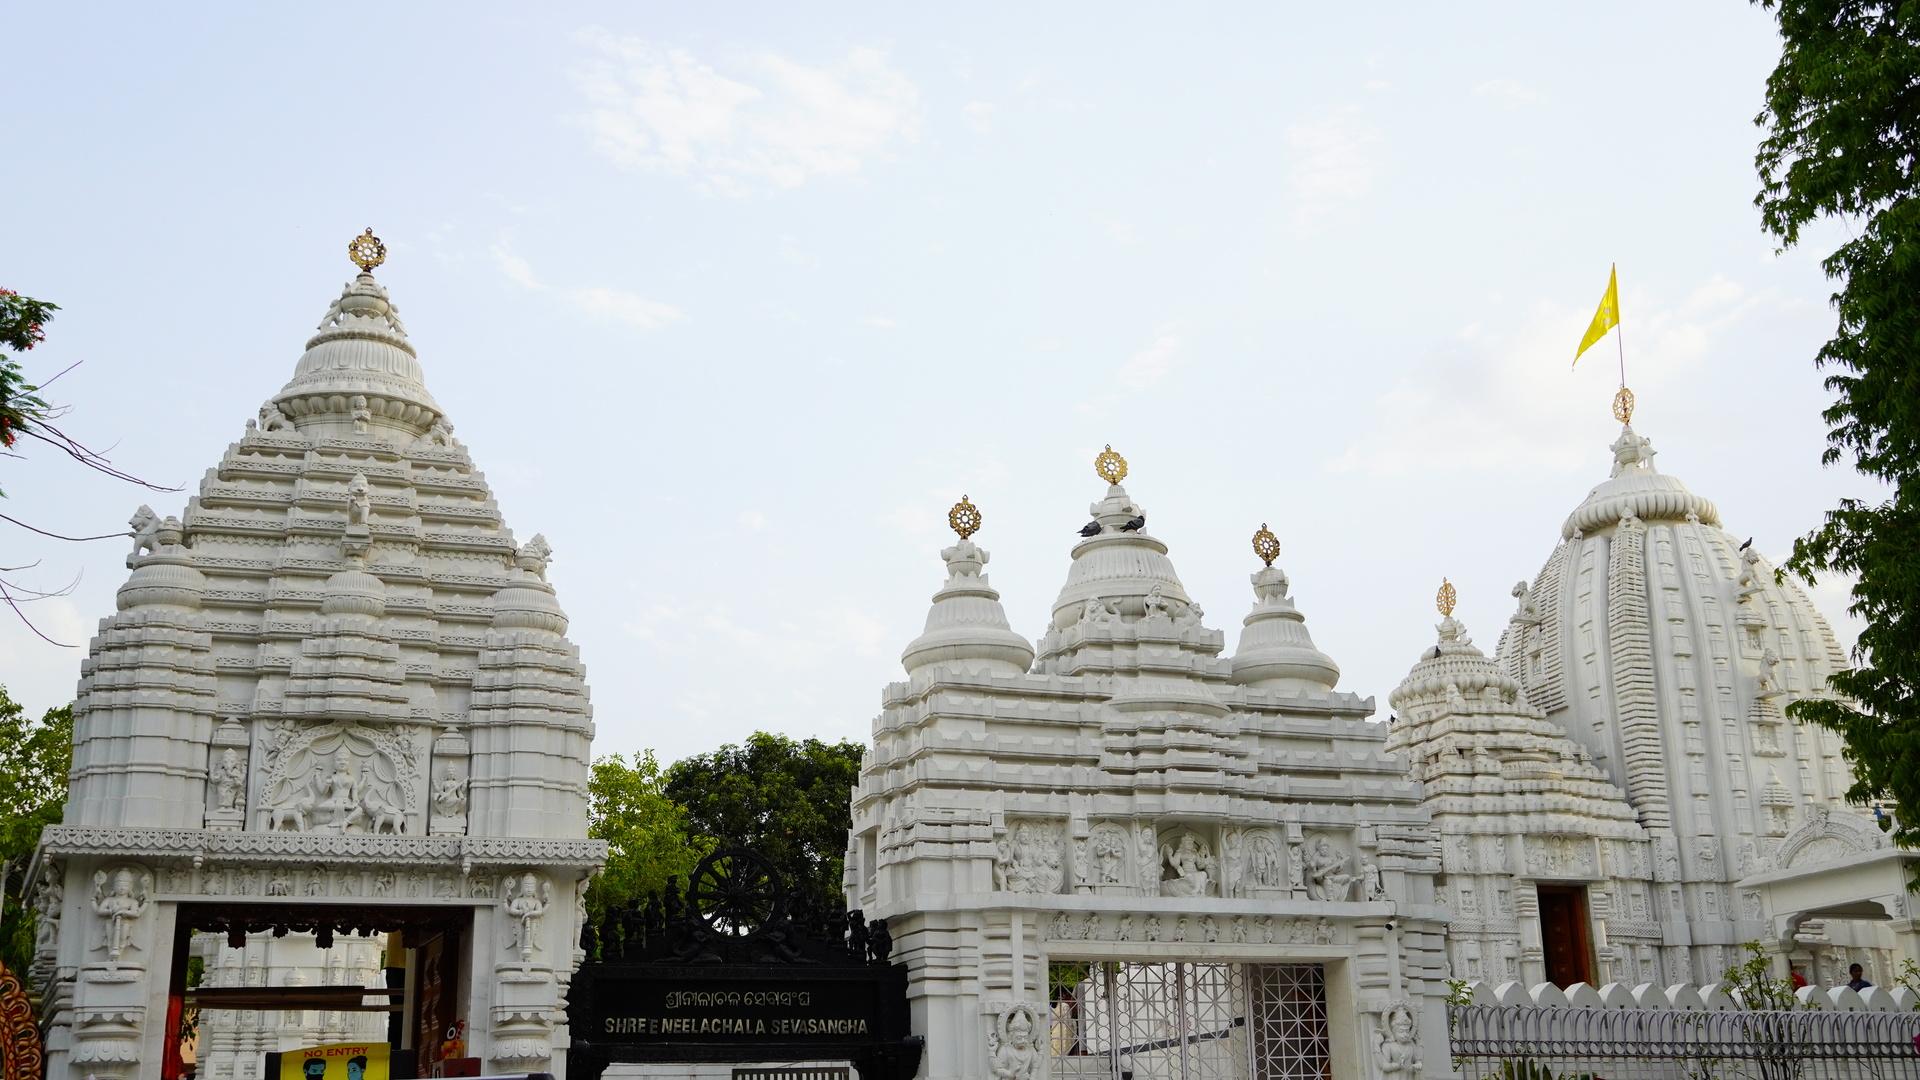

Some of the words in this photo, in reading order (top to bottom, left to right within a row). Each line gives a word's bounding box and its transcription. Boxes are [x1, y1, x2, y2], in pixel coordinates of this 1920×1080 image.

[604, 1017, 659, 1034] SHREE
[661, 1017, 766, 1035] NEELACHALA
[770, 1017, 869, 1035] SEVASANGHA
[303, 1049, 323, 1058] NO
[327, 1046, 369, 1057] ENTRY
